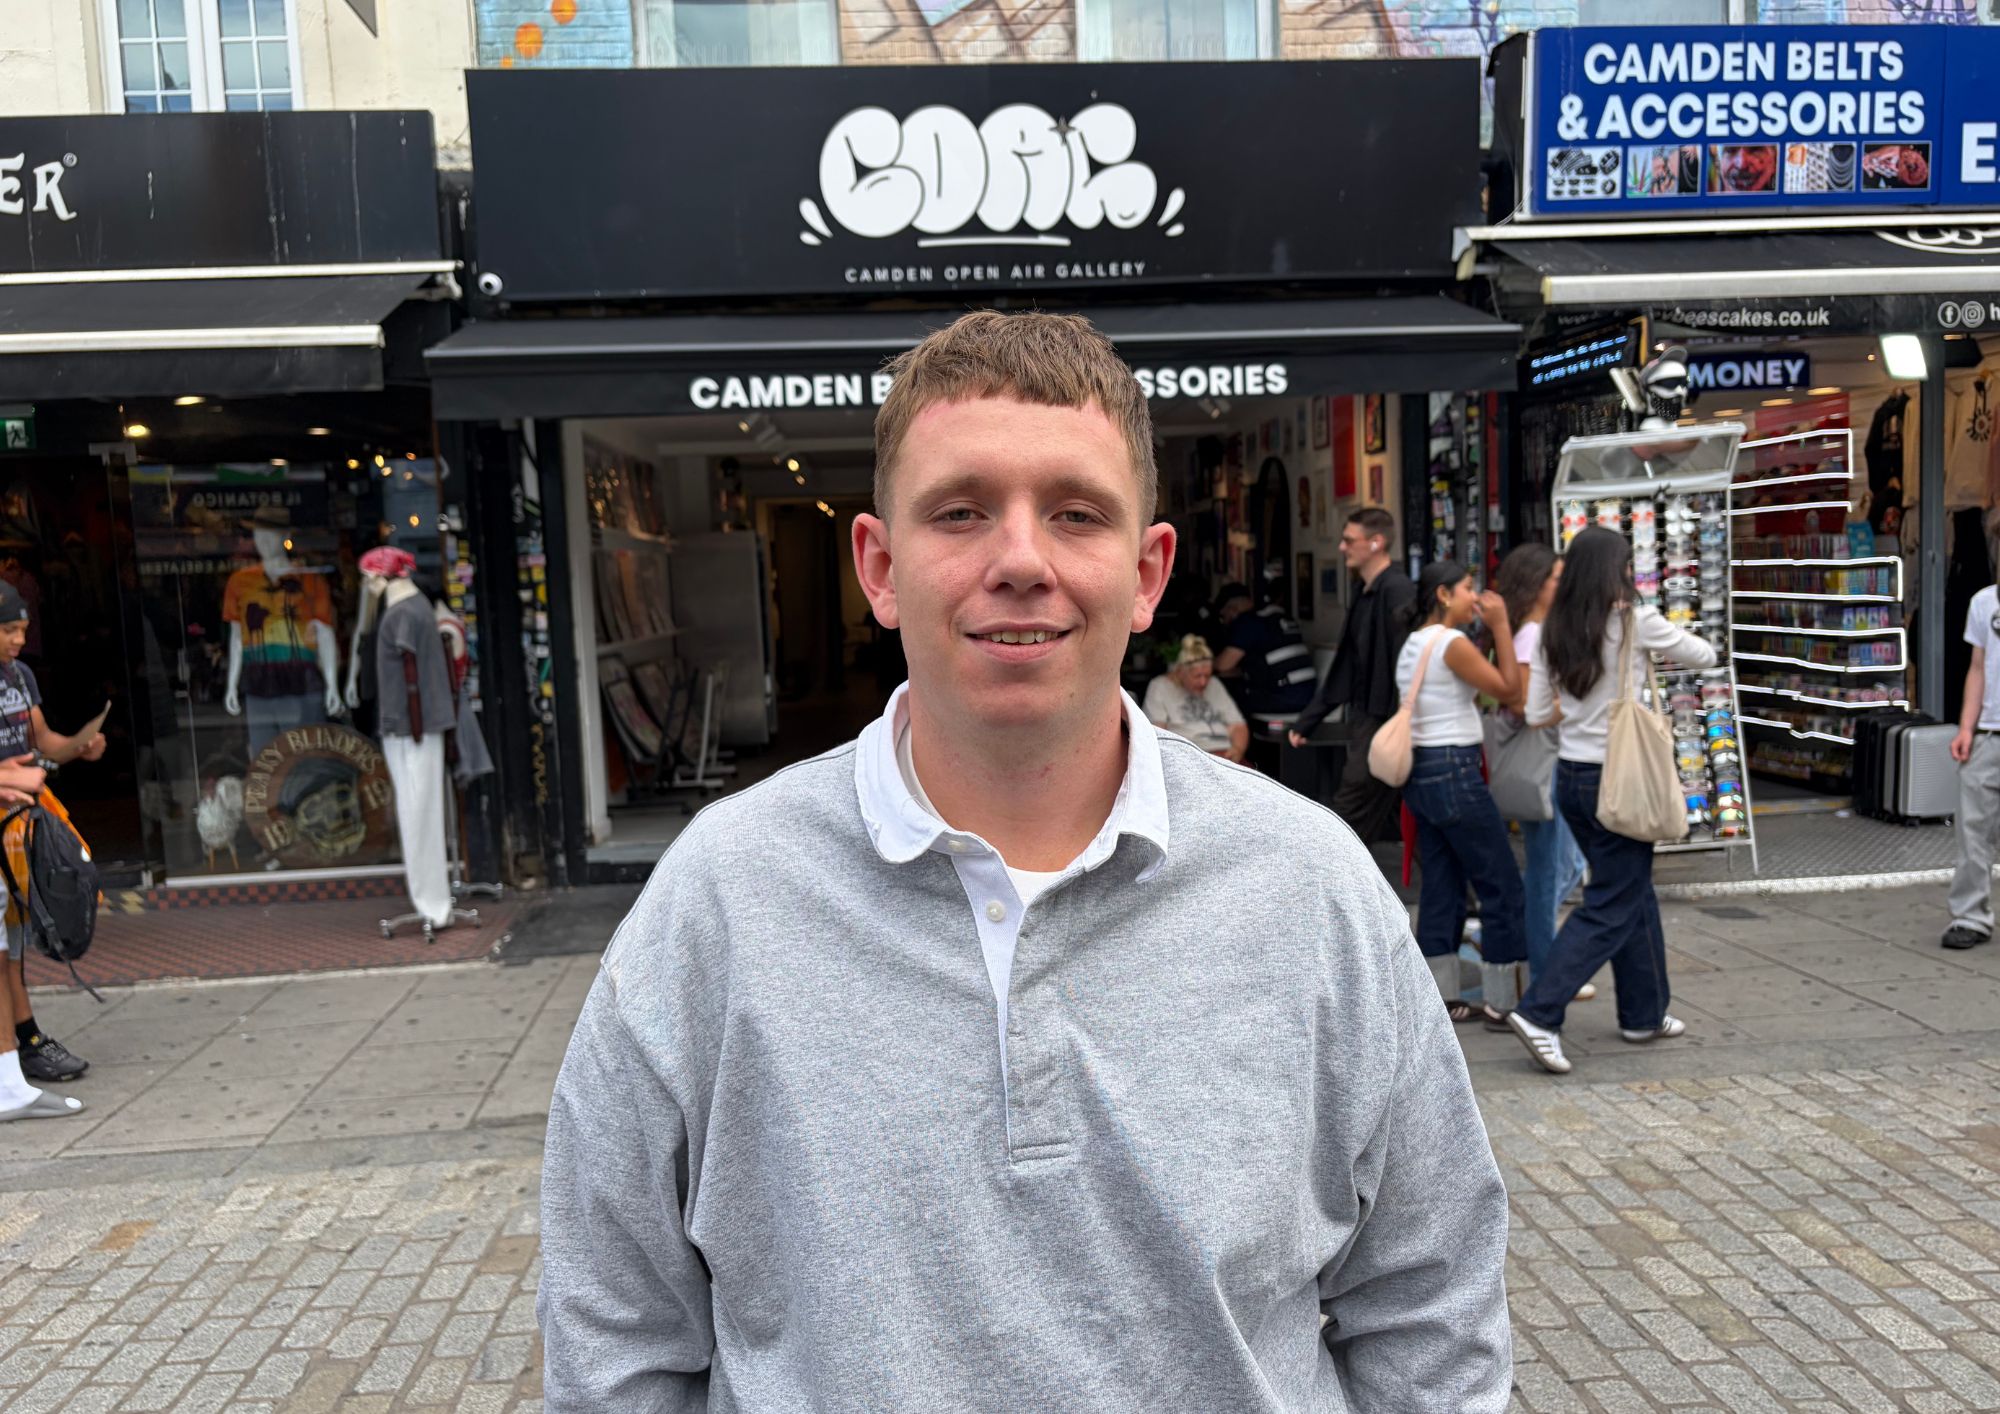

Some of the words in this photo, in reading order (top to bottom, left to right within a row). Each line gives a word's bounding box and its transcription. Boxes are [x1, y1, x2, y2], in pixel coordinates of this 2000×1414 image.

[1583, 41, 1776, 84] CAMDEN
[1786, 40, 1904, 82] BELTS
[1556, 93, 1590, 142] &
[1595, 90, 1925, 140] ACCESSORIES
[844, 267, 934, 283] CAMDEN
[943, 265, 1000, 282] OPEN
[1009, 264, 1046, 280] AIR
[1055, 261, 1147, 278] GALLERY
[689, 373, 863, 410] CAMDEN
[1133, 363, 1288, 399] SSORIES
[1687, 358, 1805, 389] MONEY
[286, 727, 382, 775] BLINDERS
